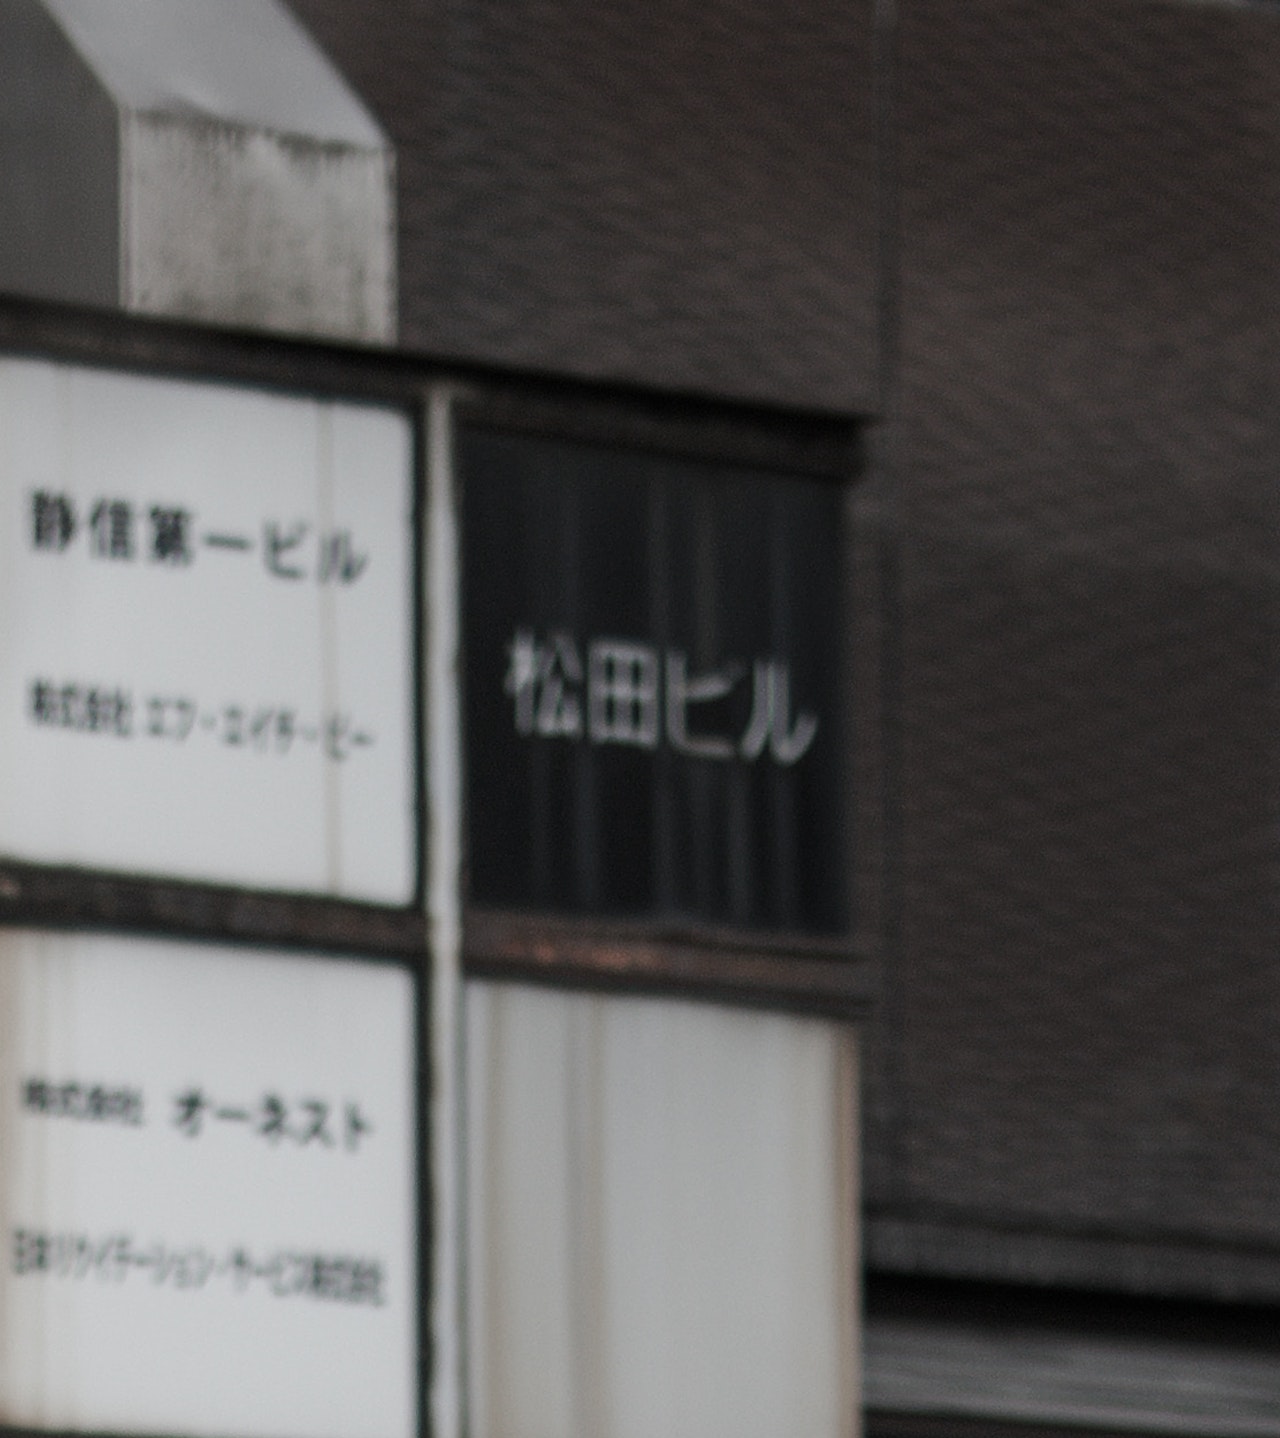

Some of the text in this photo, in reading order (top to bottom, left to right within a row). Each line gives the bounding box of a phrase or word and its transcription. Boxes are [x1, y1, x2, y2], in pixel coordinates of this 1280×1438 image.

[172, 1087, 372, 1154] オーネスト
